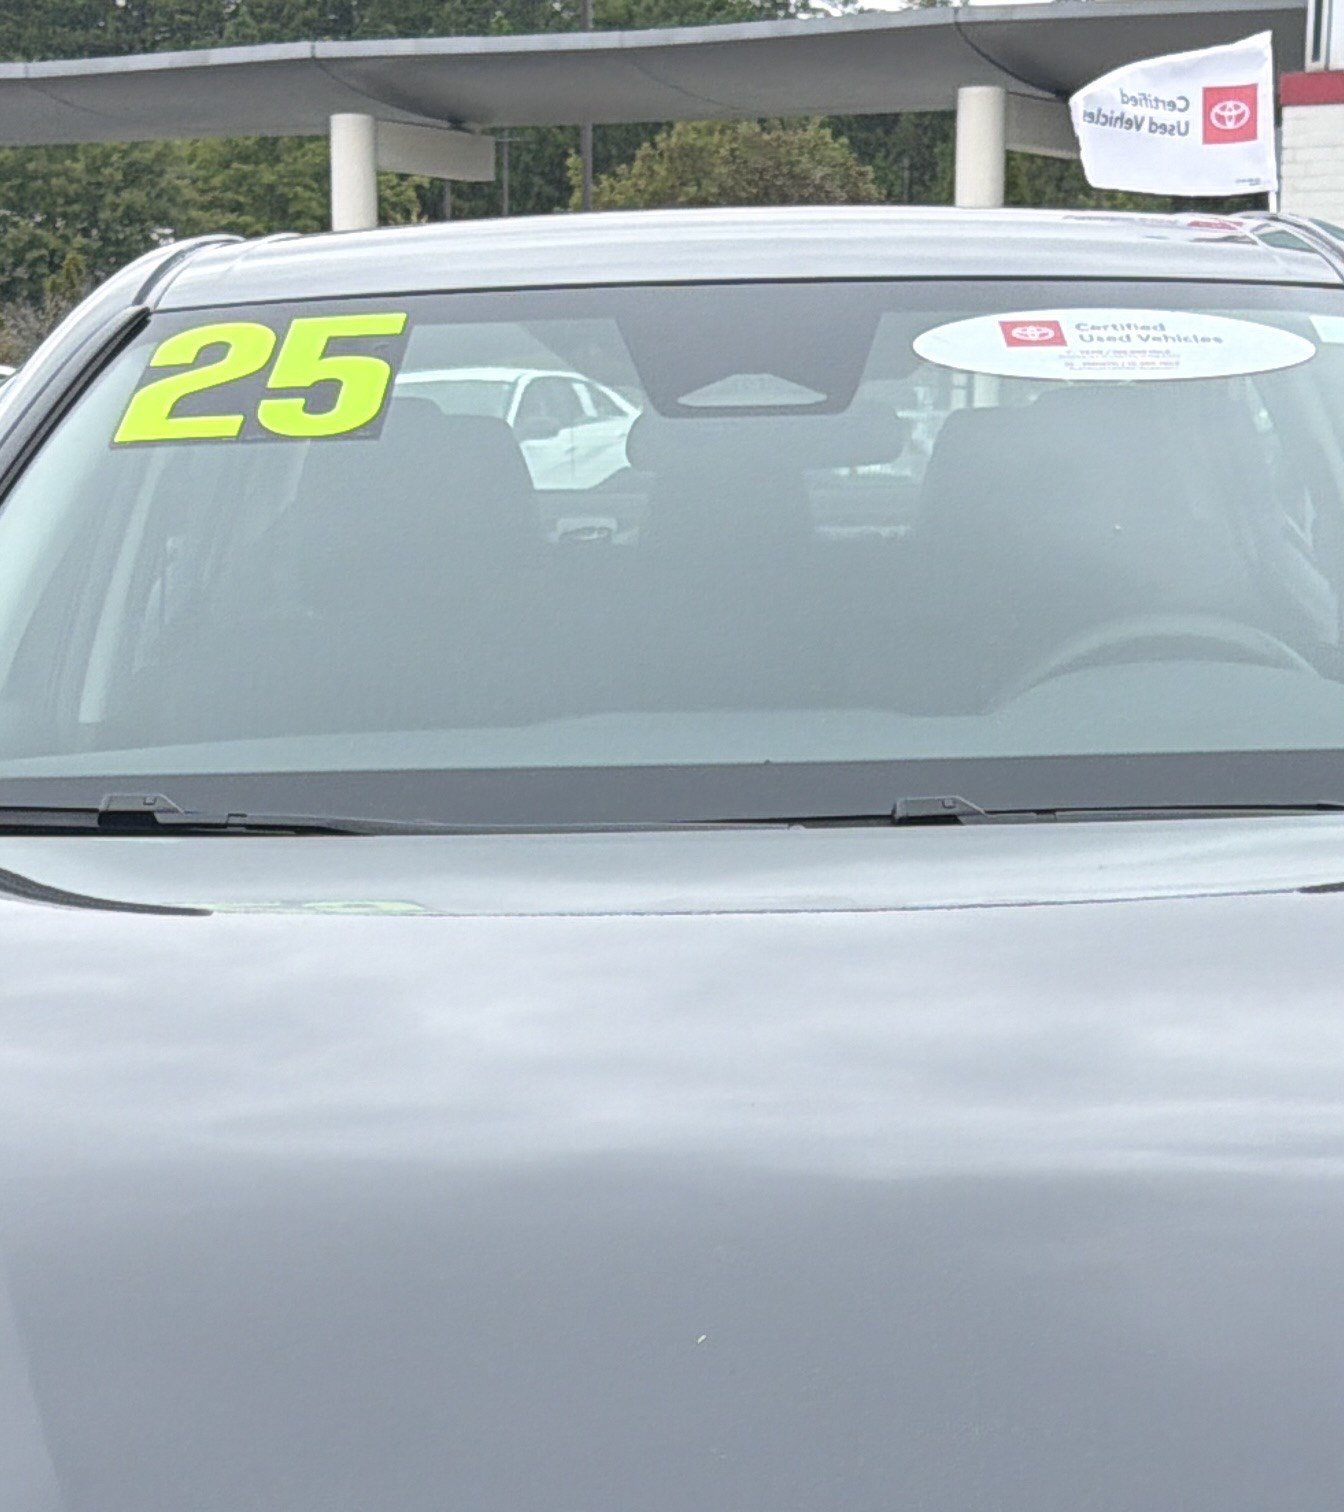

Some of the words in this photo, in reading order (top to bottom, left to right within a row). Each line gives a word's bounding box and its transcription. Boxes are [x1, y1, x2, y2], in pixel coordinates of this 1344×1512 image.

[1074, 322, 1167, 332] Certified
[1079, 333, 1132, 343] Used
[1137, 333, 1223, 344] Vehicles
[113, 312, 407, 443] 25
